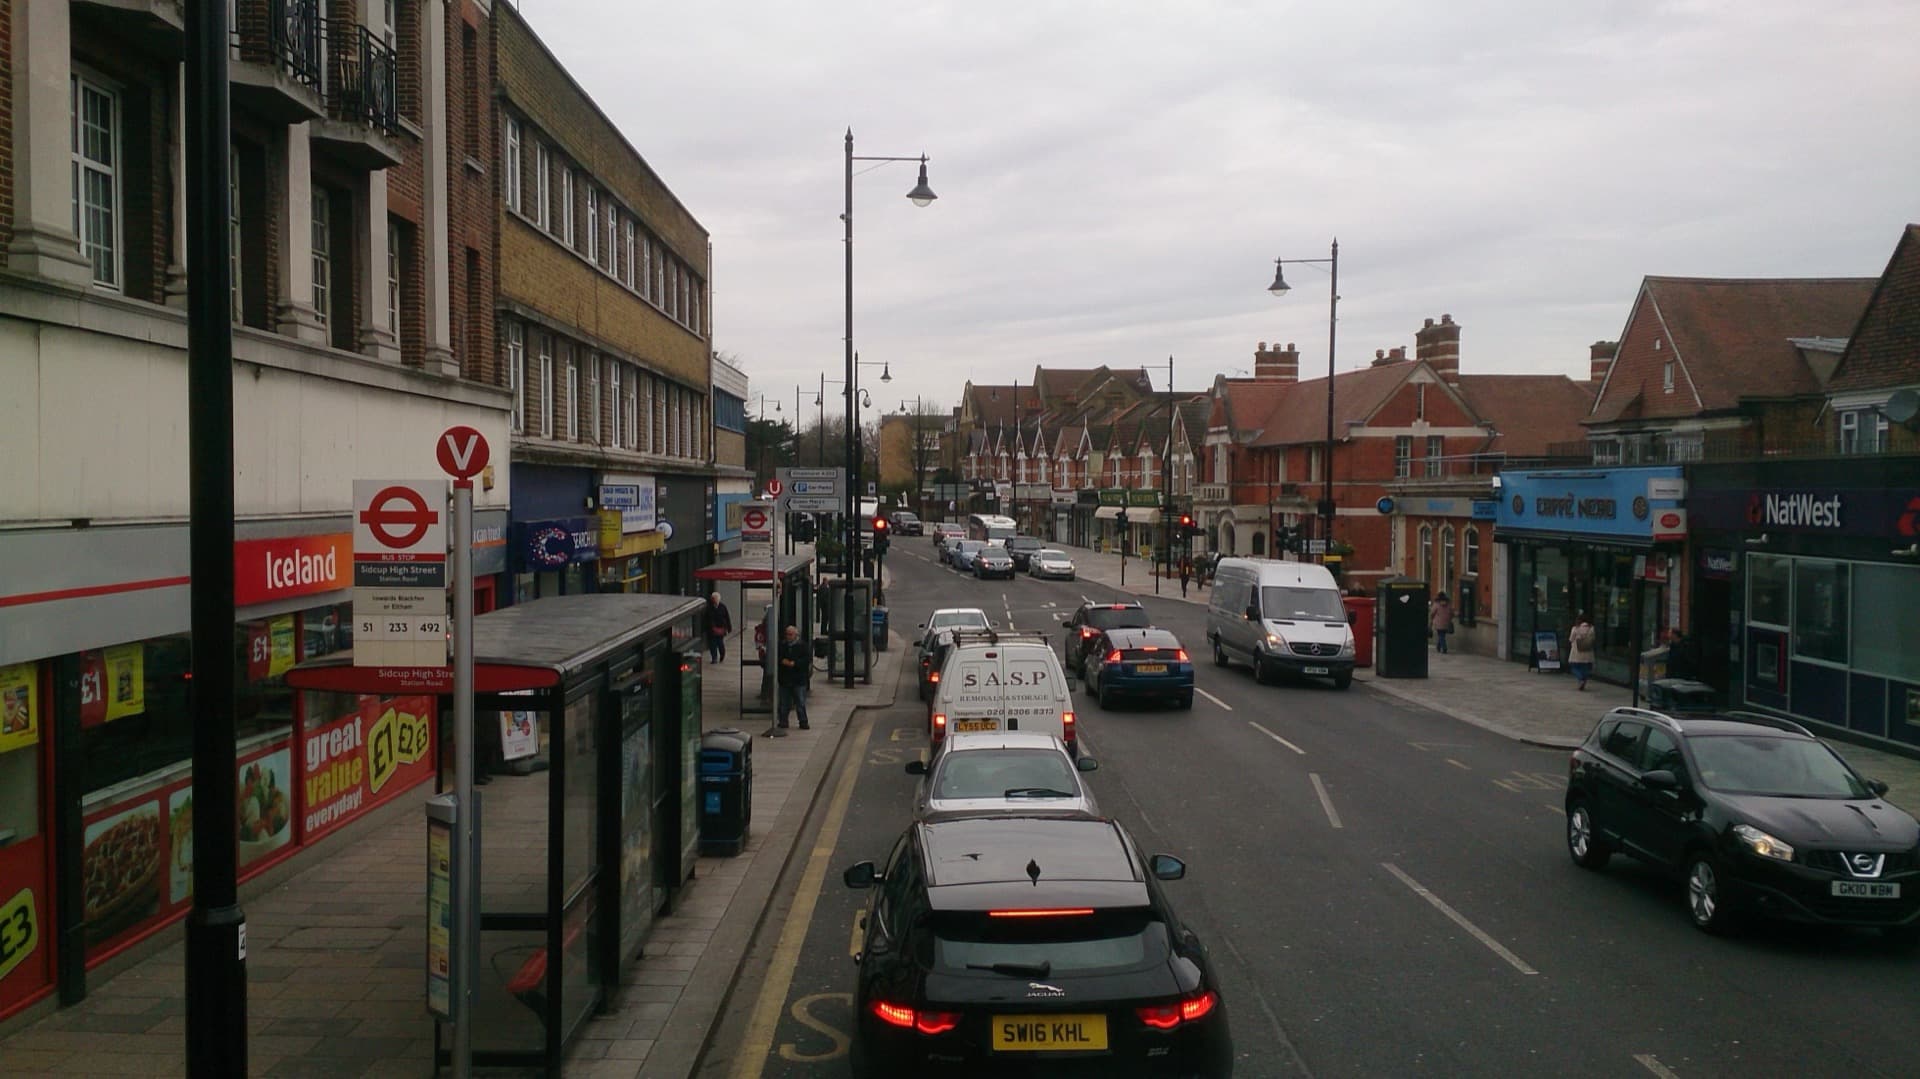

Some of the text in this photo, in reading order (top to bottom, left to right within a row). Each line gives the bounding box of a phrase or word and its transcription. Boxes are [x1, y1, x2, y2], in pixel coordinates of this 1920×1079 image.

[444, 433, 478, 471] V
[769, 481, 780, 494] U
[1766, 492, 1841, 528] NatWest
[265, 544, 337, 590] Iceland
[360, 564, 437, 575] Sidcup High Street
[362, 623, 373, 632] 51
[389, 623, 408, 632] 233
[420, 623, 440, 632] 492
[253, 635, 268, 663] £1
[80, 671, 102, 705] £1
[378, 669, 454, 680] Sidcup High Stre
[306, 714, 428, 785] great £1 £2 £3
[306, 754, 363, 808] value
[306, 786, 363, 834] everyday!
[1004, 1024, 1090, 1043] SW16 KHL
